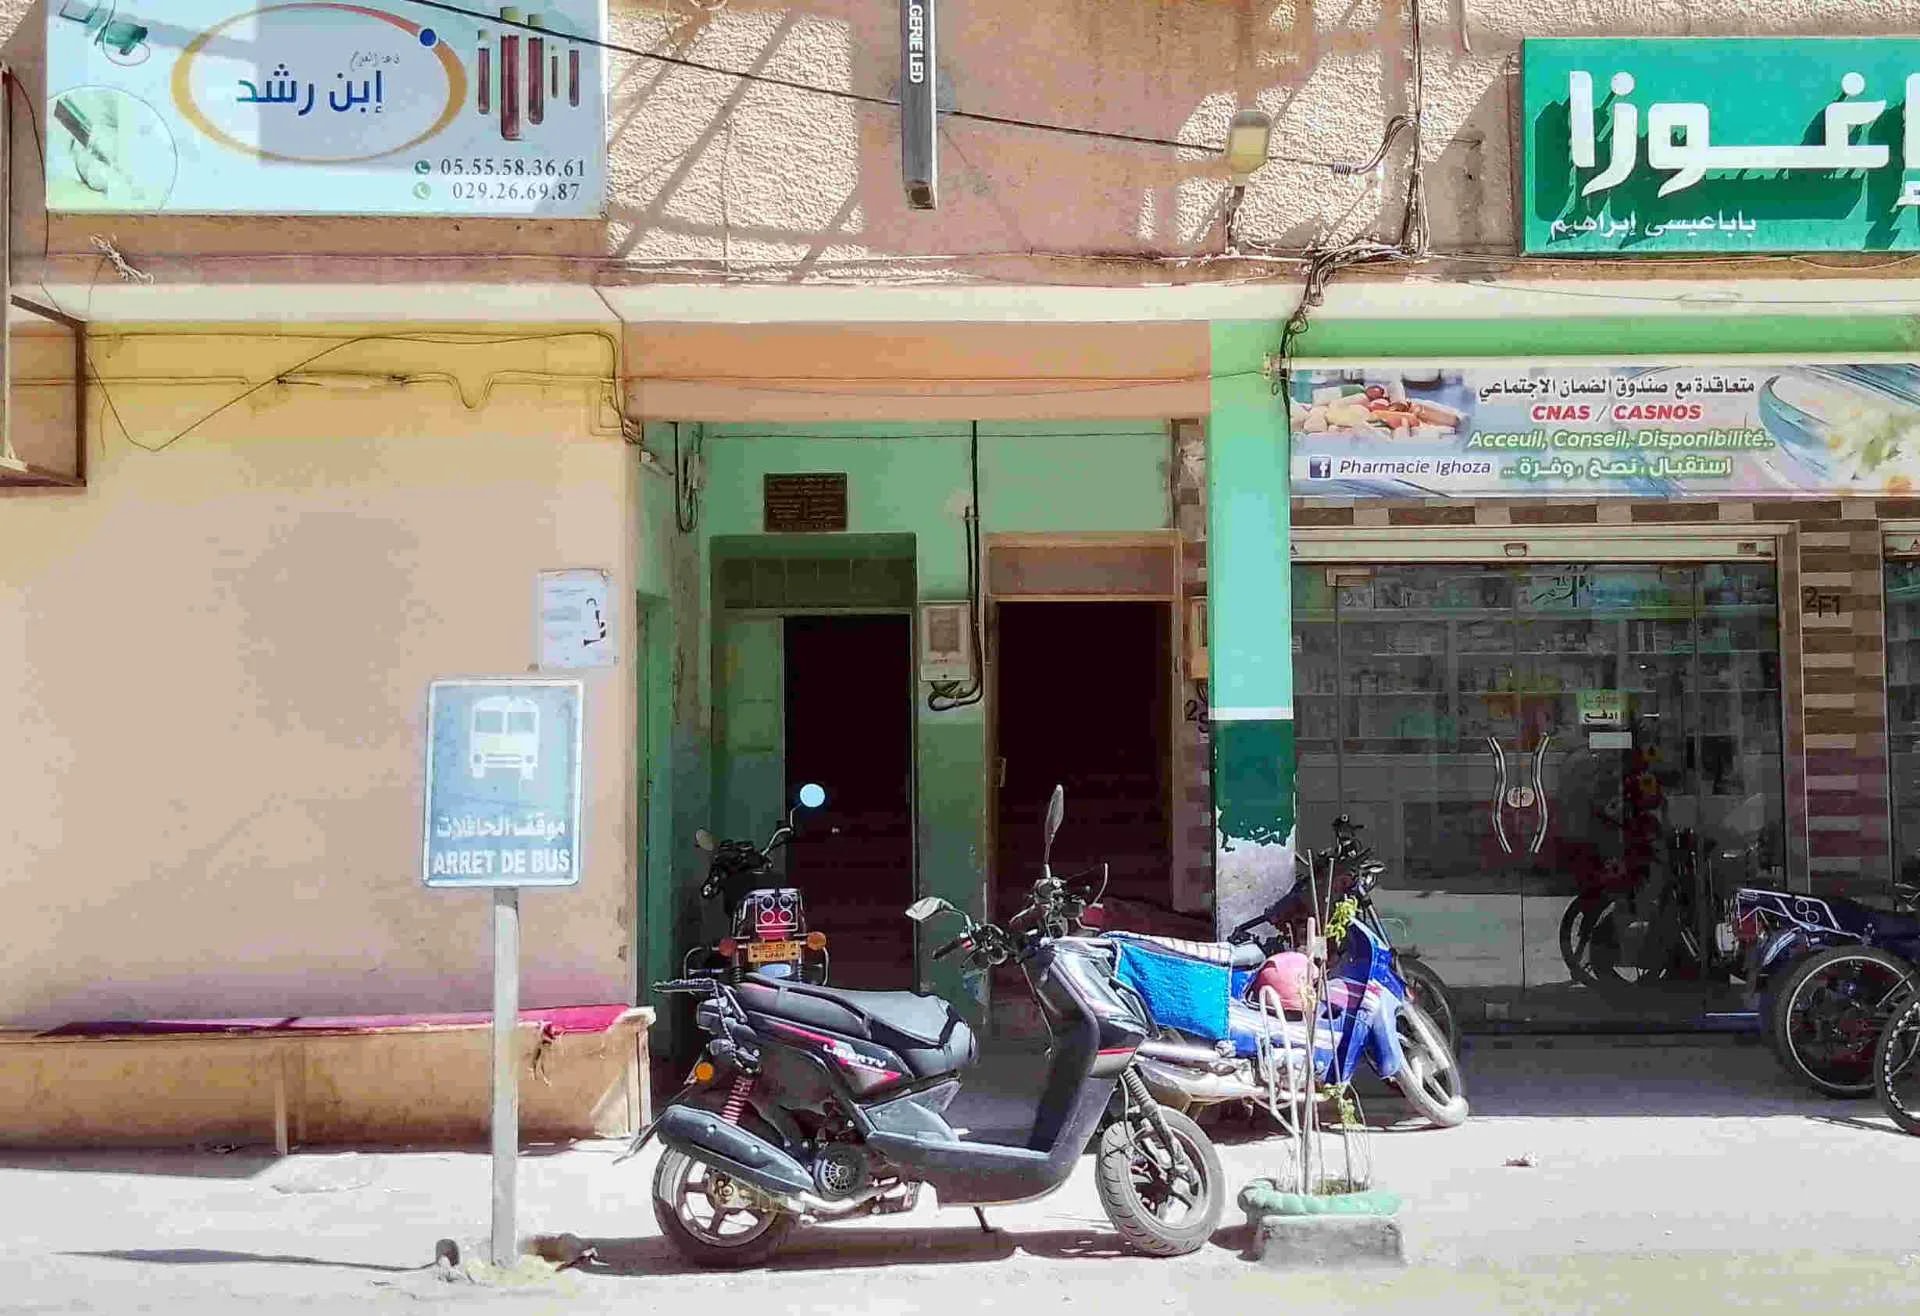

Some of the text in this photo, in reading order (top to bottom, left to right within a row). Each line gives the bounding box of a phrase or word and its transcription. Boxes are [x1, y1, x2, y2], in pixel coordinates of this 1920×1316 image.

[909, 53, 924, 83] LED
[236, 63, 315, 116] رشد
[440, 157, 585, 177] 05.55.58.36.61
[452, 181, 580, 201] 029.26.69.87
[1560, 378, 1612, 398] الضمان
[1615, 378, 1669, 398] صندوق
[1674, 380, 1692, 399] مع
[1695, 376, 1755, 394] متعاقدة
[1532, 405, 1591, 420] CNAS
[1614, 404, 1702, 420] CASNOS
[1467, 430, 1548, 449] Acceuil,
[1339, 459, 1492, 477] Pharmacie Ighoza
[513, 812, 566, 844] موقف
[433, 848, 571, 874] ARRET DE BUS
